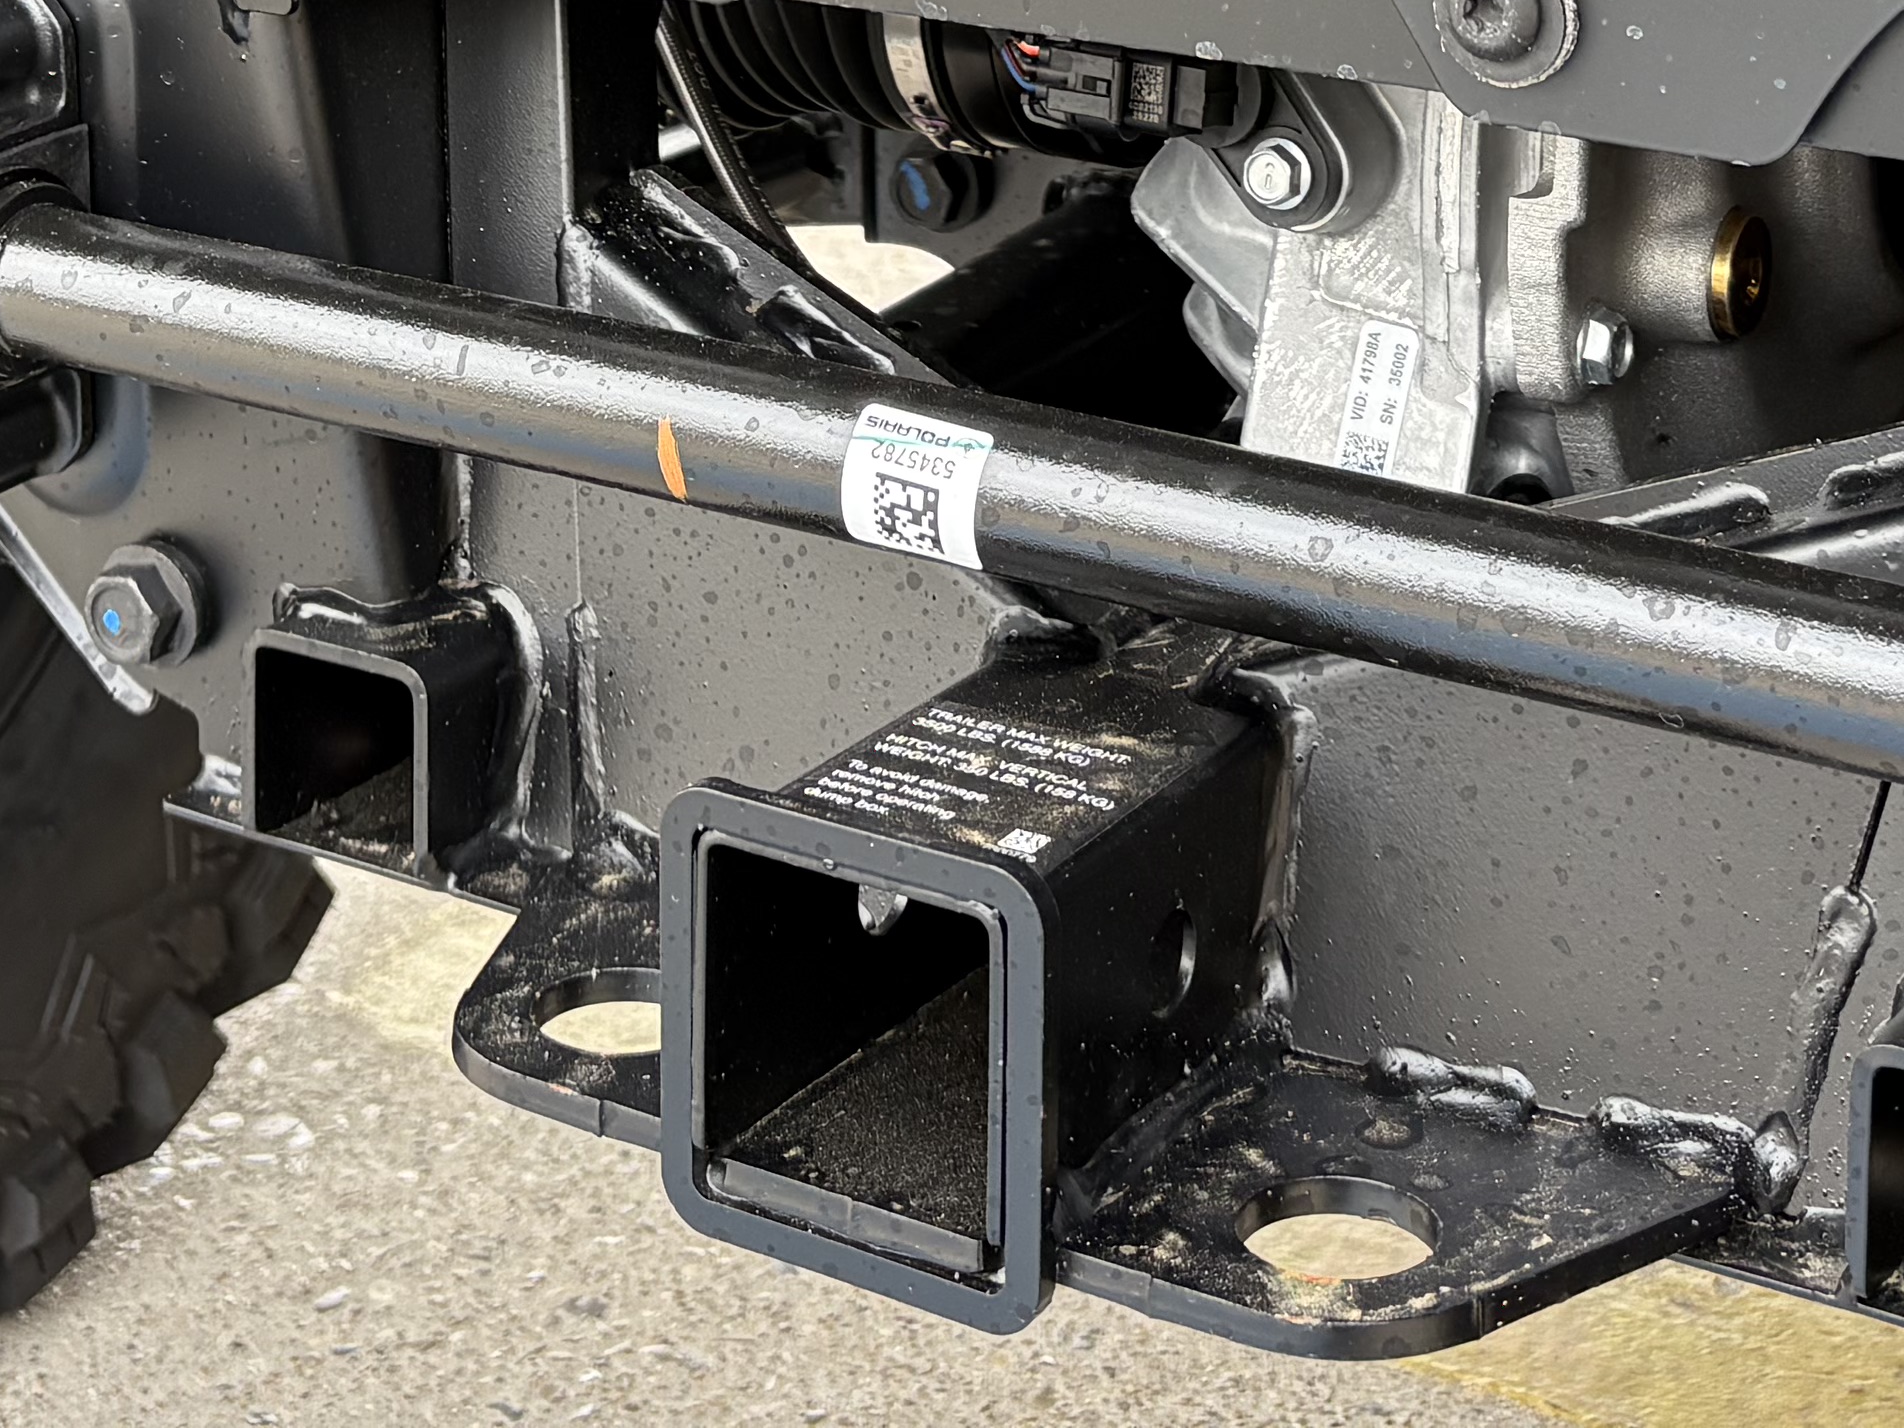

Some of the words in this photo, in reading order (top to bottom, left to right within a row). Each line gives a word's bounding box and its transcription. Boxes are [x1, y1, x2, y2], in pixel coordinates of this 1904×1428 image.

[1350, 391, 1369, 420] VID:
[1379, 398, 1398, 425] SN:
[864, 415, 951, 448] POLARIS
[871, 441, 956, 479] 5345782
[912, 716, 957, 735] 3500
[1053, 750, 1091, 767] KG)
[928, 707, 1006, 733] TRAILER
[1006, 727, 1052, 744] MAX
[848, 758, 869, 771] To
[869, 766, 920, 784] avoid
[885, 733, 947, 754] HITCH
[998, 760, 1087, 791] VERTICAL
[803, 787, 854, 806] dump
[817, 776, 874, 797] before
[875, 792, 957, 821] operating
[831, 769, 897, 791] remove
[897, 784, 940, 802] hitch
[953, 762, 989, 777] 350
[1077, 793, 1115, 811] KG)
